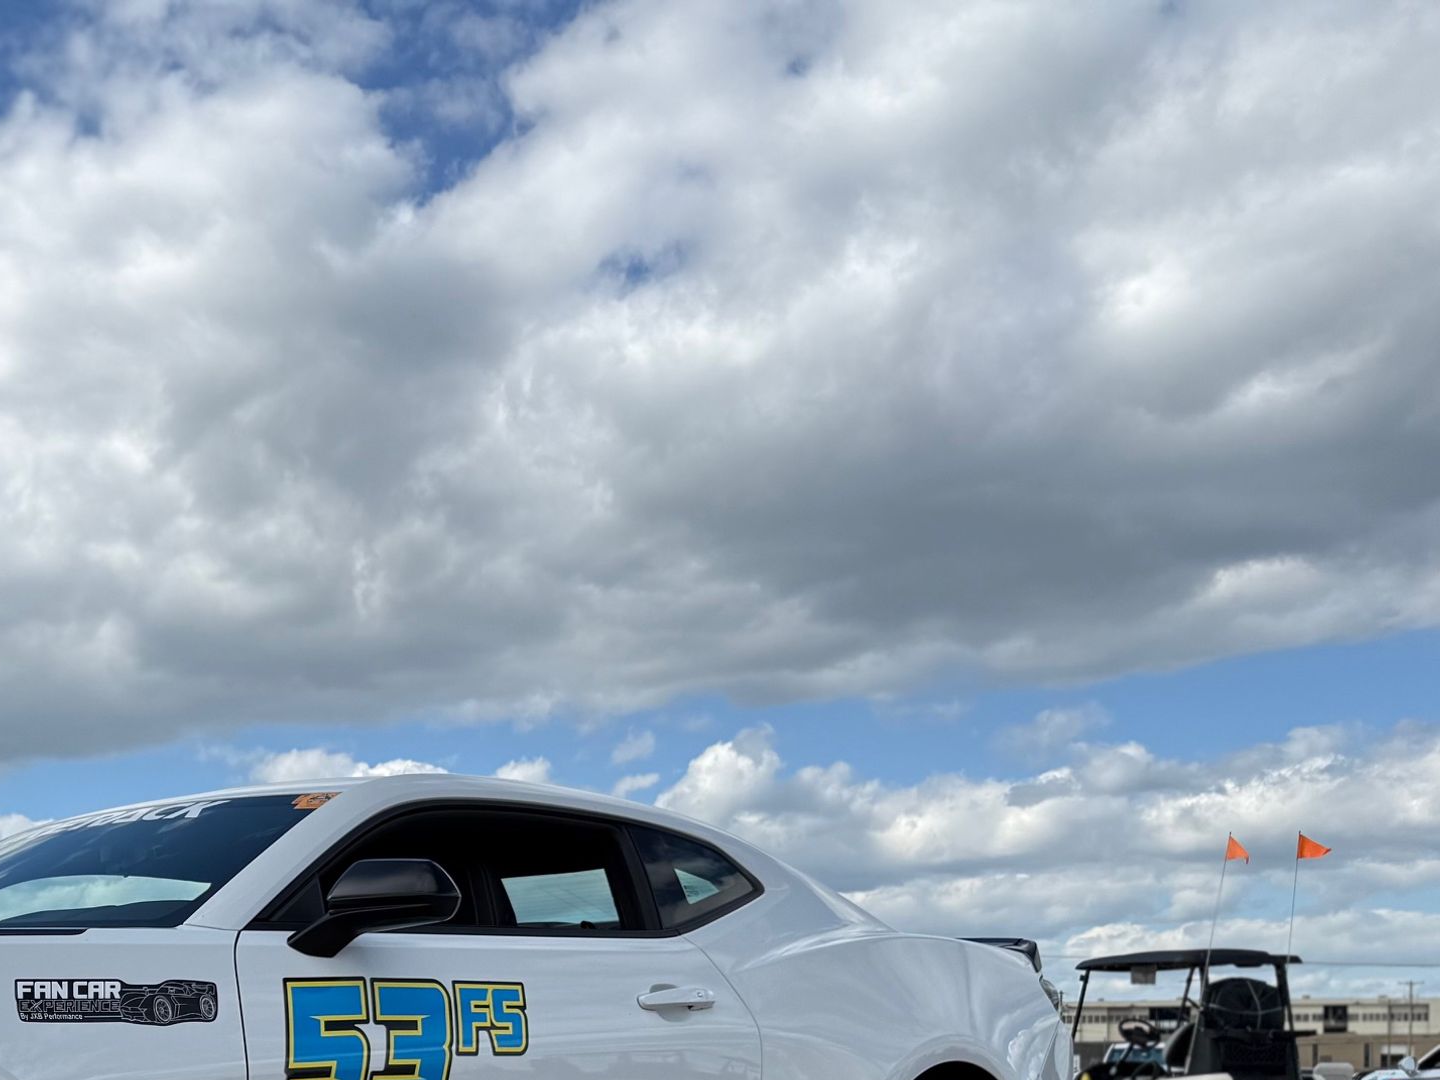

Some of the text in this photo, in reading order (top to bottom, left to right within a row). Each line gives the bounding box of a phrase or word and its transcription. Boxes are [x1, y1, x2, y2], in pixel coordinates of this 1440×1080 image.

[16, 981, 121, 999] FAN CAR
[19, 1000, 120, 1012] EXPERIENCE
[452, 980, 529, 1056] FS
